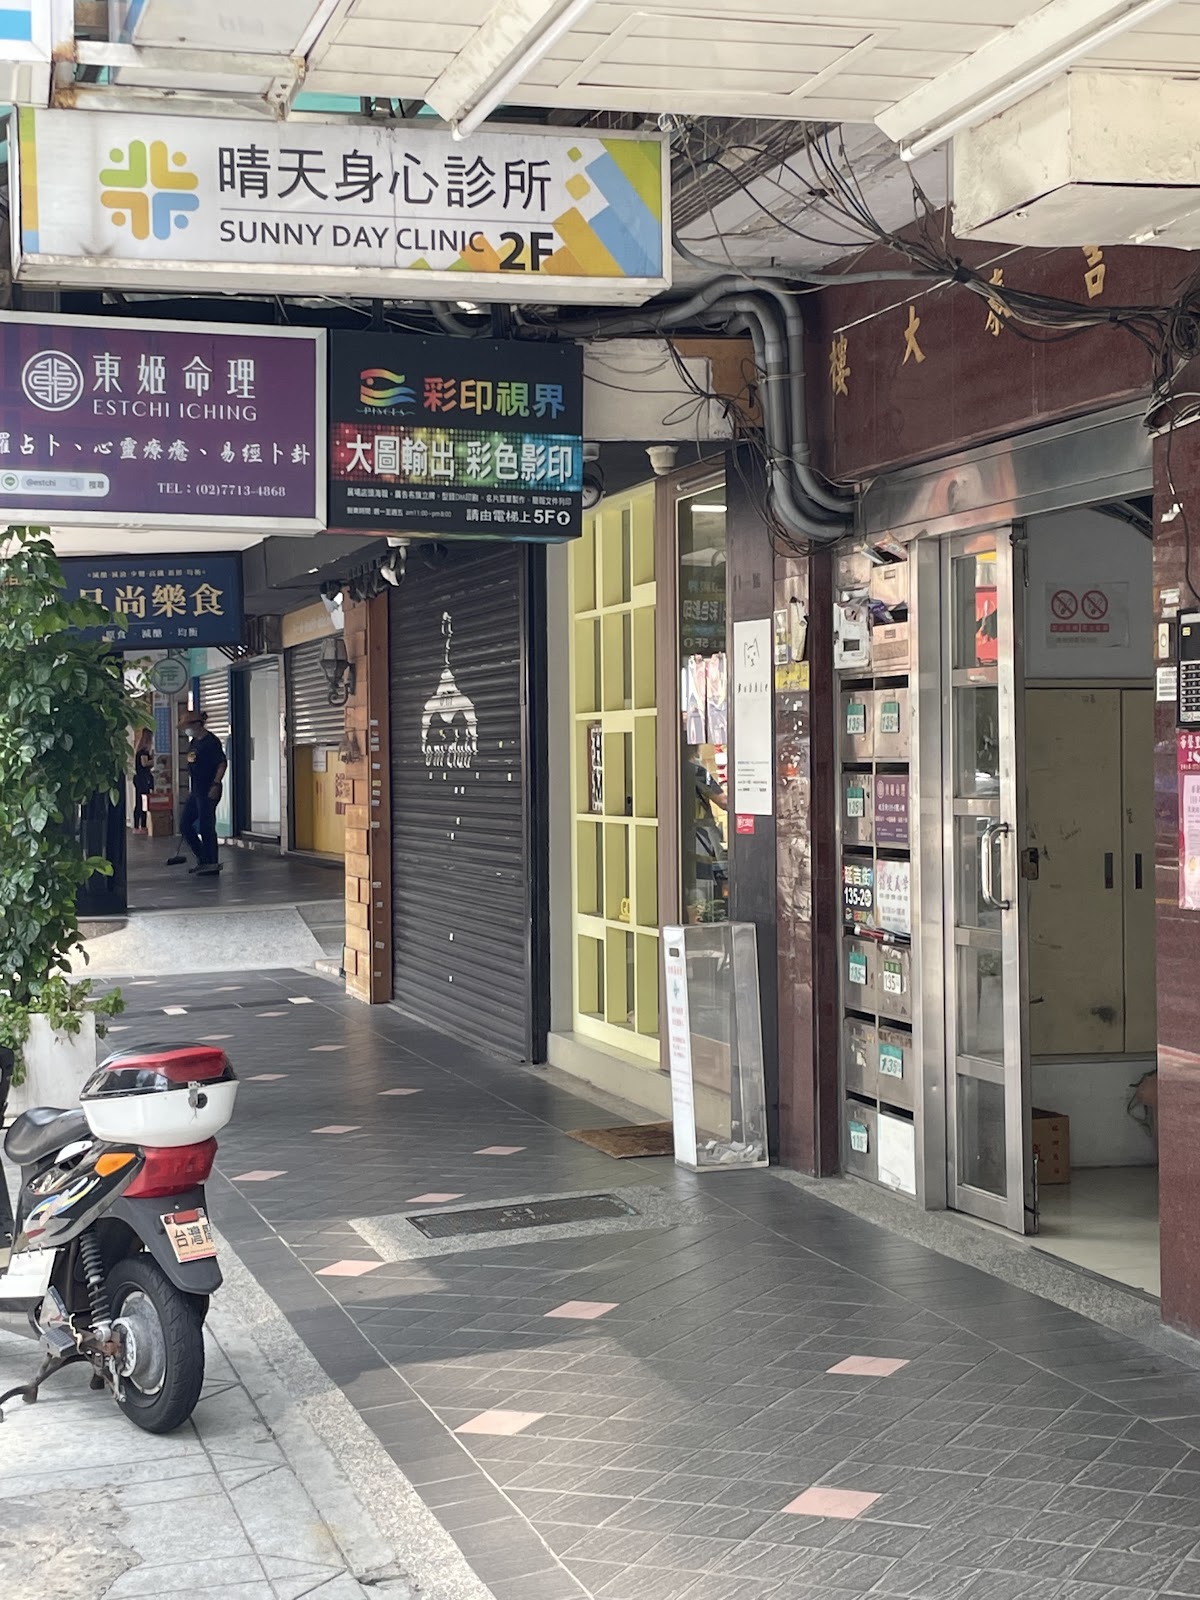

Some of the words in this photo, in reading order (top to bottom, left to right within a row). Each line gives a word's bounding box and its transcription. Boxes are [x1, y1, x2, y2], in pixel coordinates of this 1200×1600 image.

[218, 144, 552, 213] 晴天身心診所
[220, 220, 322, 248] SUNNY
[332, 223, 388, 250] DAY
[395, 225, 485, 253] CLINIC
[499, 230, 555, 272] 2F
[92, 352, 256, 399] 東姬命理
[93, 399, 170, 417] ESTCHI
[179, 403, 257, 421] ICHING
[423, 377, 565, 419] 彩印視界
[346, 434, 455, 480] 大圖輸出
[466, 441, 573, 483] 彩色影印
[466, 509, 532, 524] 請由電梯上
[534, 509, 556, 524] 5F
